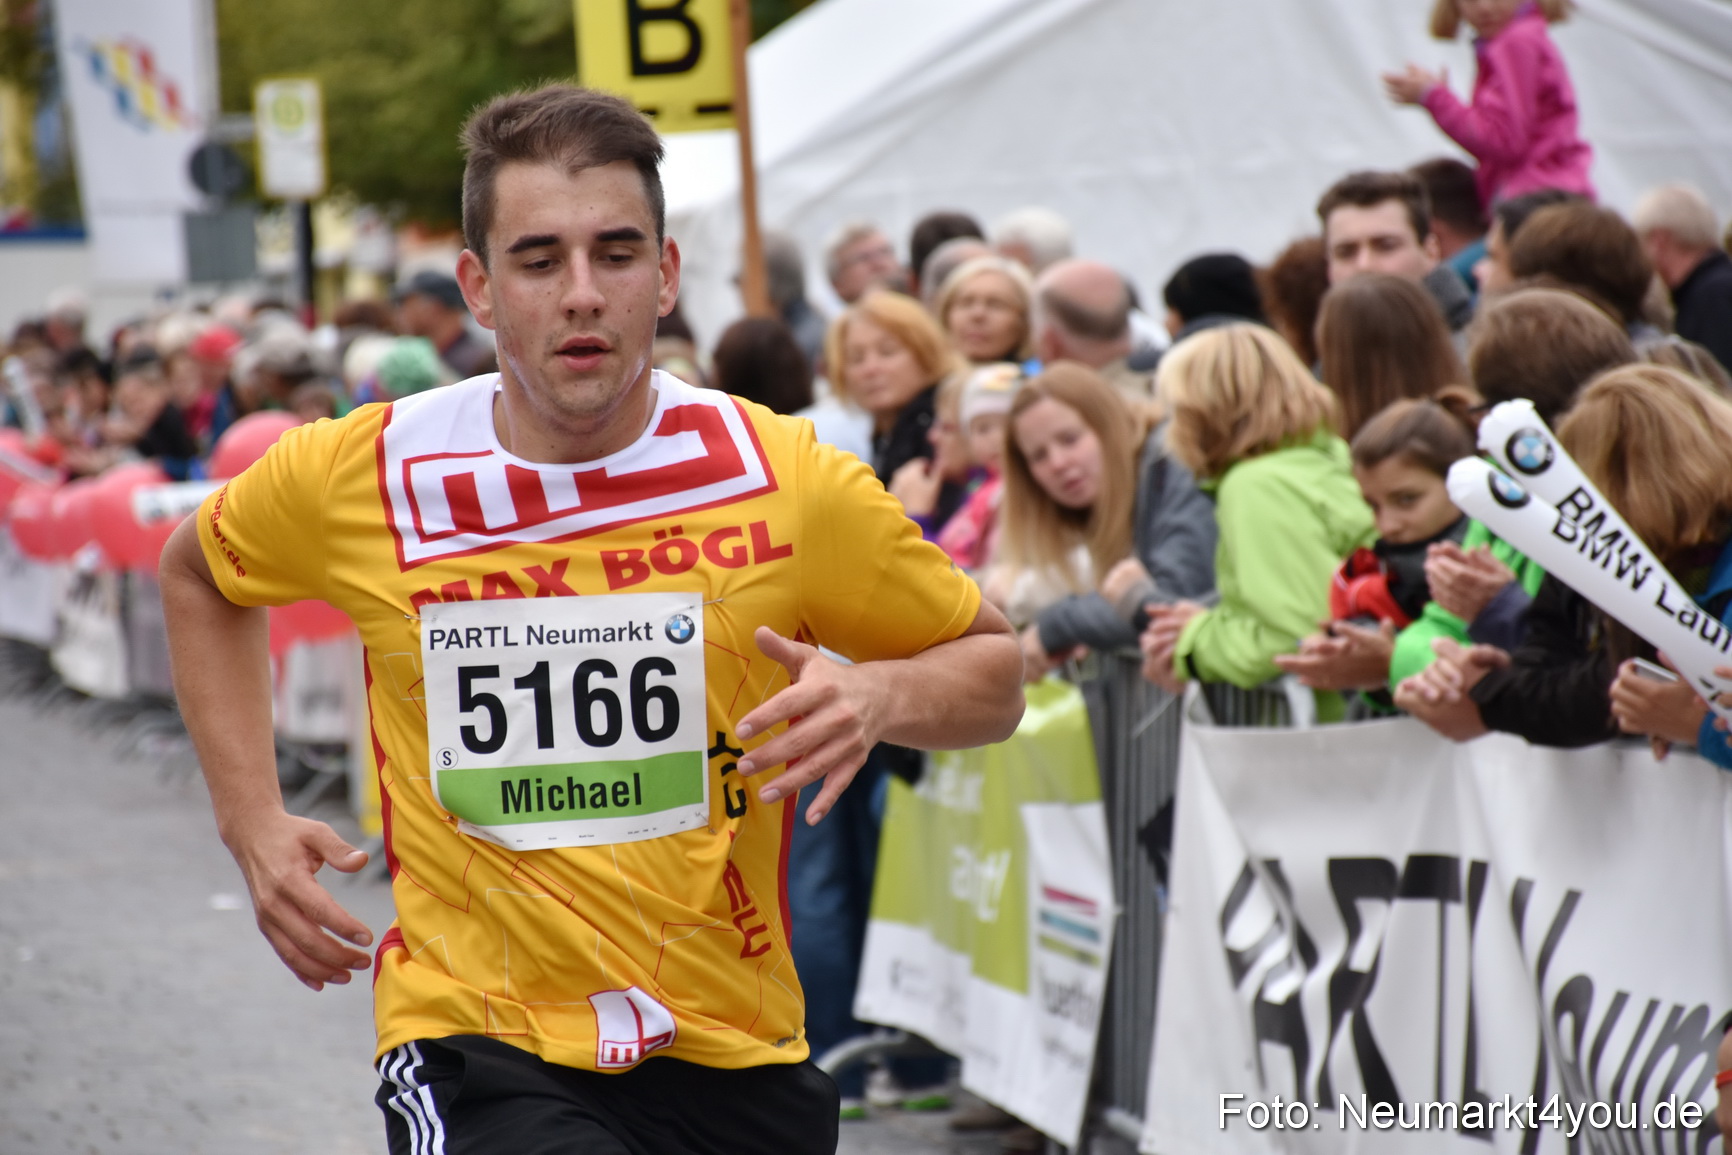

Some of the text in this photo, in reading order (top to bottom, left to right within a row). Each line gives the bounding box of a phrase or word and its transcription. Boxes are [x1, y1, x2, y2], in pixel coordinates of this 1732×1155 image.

[627, 0, 703, 77] B
[600, 520, 793, 591] BÖGL
[429, 621, 653, 651] PARTL Neumarkt
[457, 656, 681, 755] 5166
[501, 772, 643, 815] Michael
